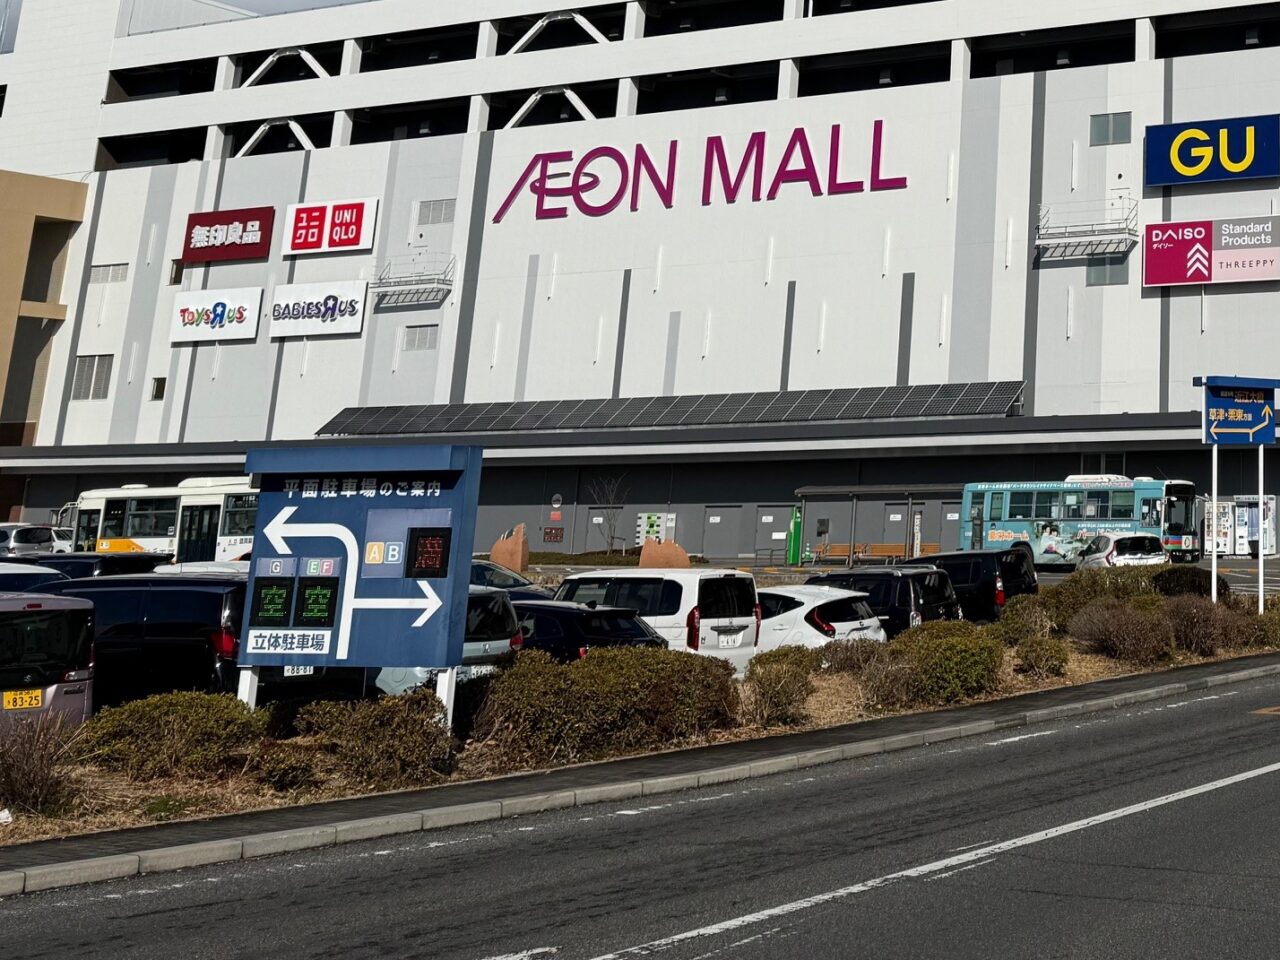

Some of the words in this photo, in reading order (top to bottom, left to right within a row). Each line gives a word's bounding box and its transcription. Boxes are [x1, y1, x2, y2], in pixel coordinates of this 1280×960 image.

[1170, 126, 1255, 177] GU
[701, 119, 908, 207] MALL
[298, 211, 320, 227] ユニ
[334, 208, 357, 224] UNI
[190, 220, 261, 248] 無印良品
[295, 227, 319, 243] クロ
[332, 224, 357, 241] QLO
[1152, 227, 1206, 242] DAISO
[1221, 221, 1272, 235] Standard
[1221, 233, 1272, 247] Products
[1219, 259, 1275, 270] THREEPPY
[282, 477, 441, 499] 平面駐車場のご案内
[368, 544, 381, 561] A
[387, 544, 400, 561] B
[271, 561, 281, 573] G
[252, 632, 325, 652] 立体駐車場
[12, 695, 40, 707] 83-25
